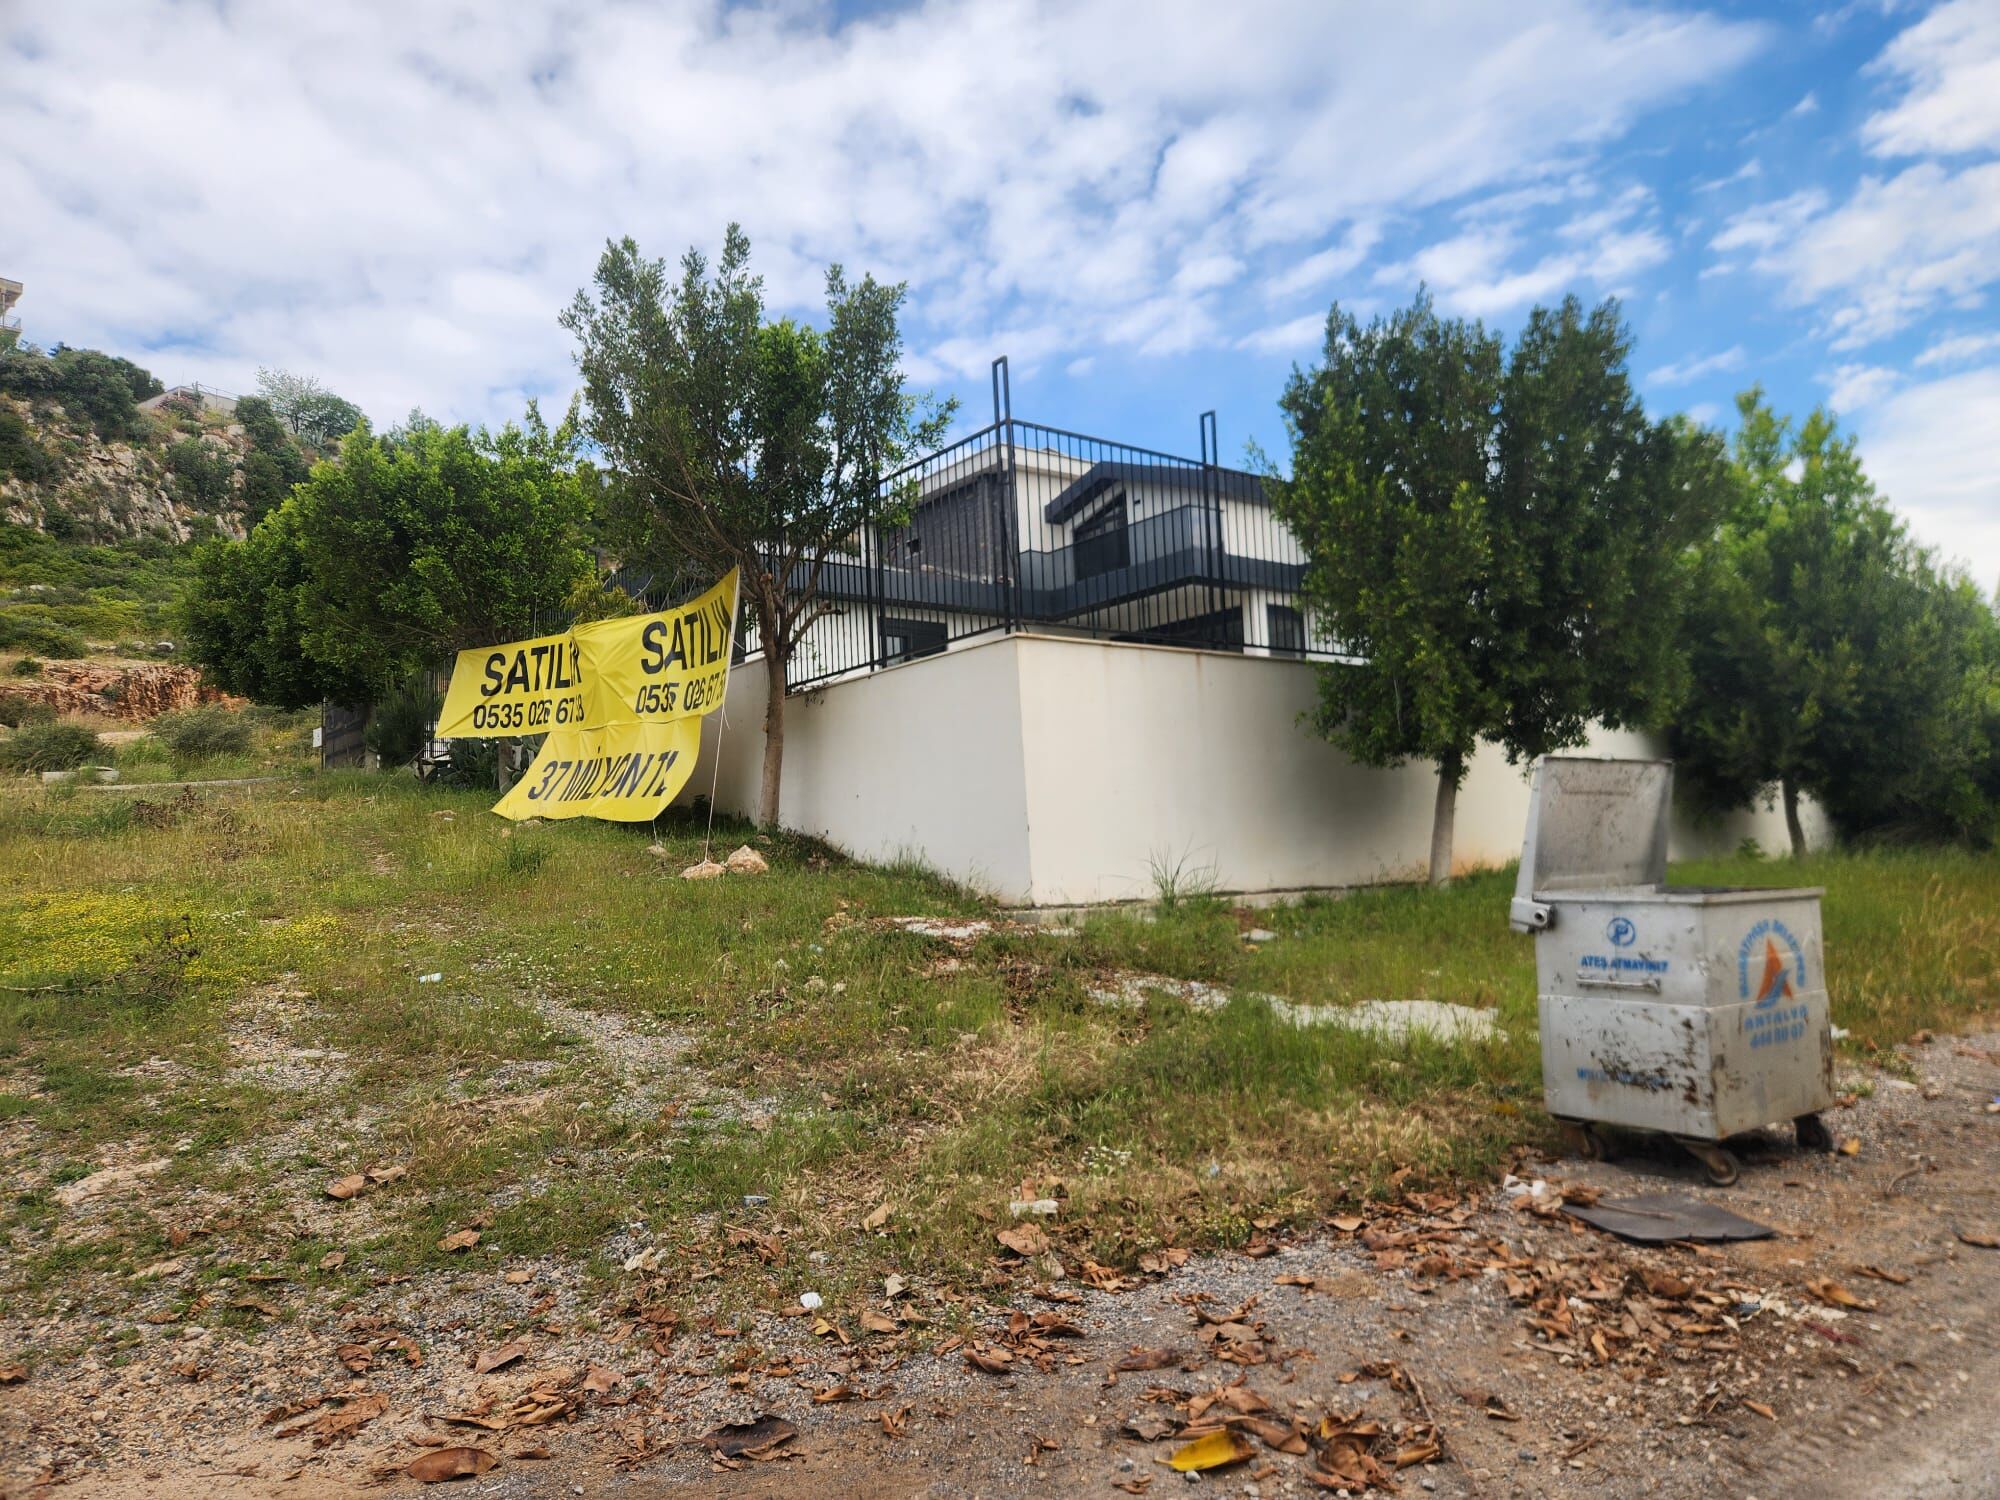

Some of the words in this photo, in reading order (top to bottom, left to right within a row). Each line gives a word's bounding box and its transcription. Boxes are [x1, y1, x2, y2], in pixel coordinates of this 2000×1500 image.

[473, 702, 524, 729] 0535
[528, 699, 553, 726] 026
[528, 760, 573, 800] 37
